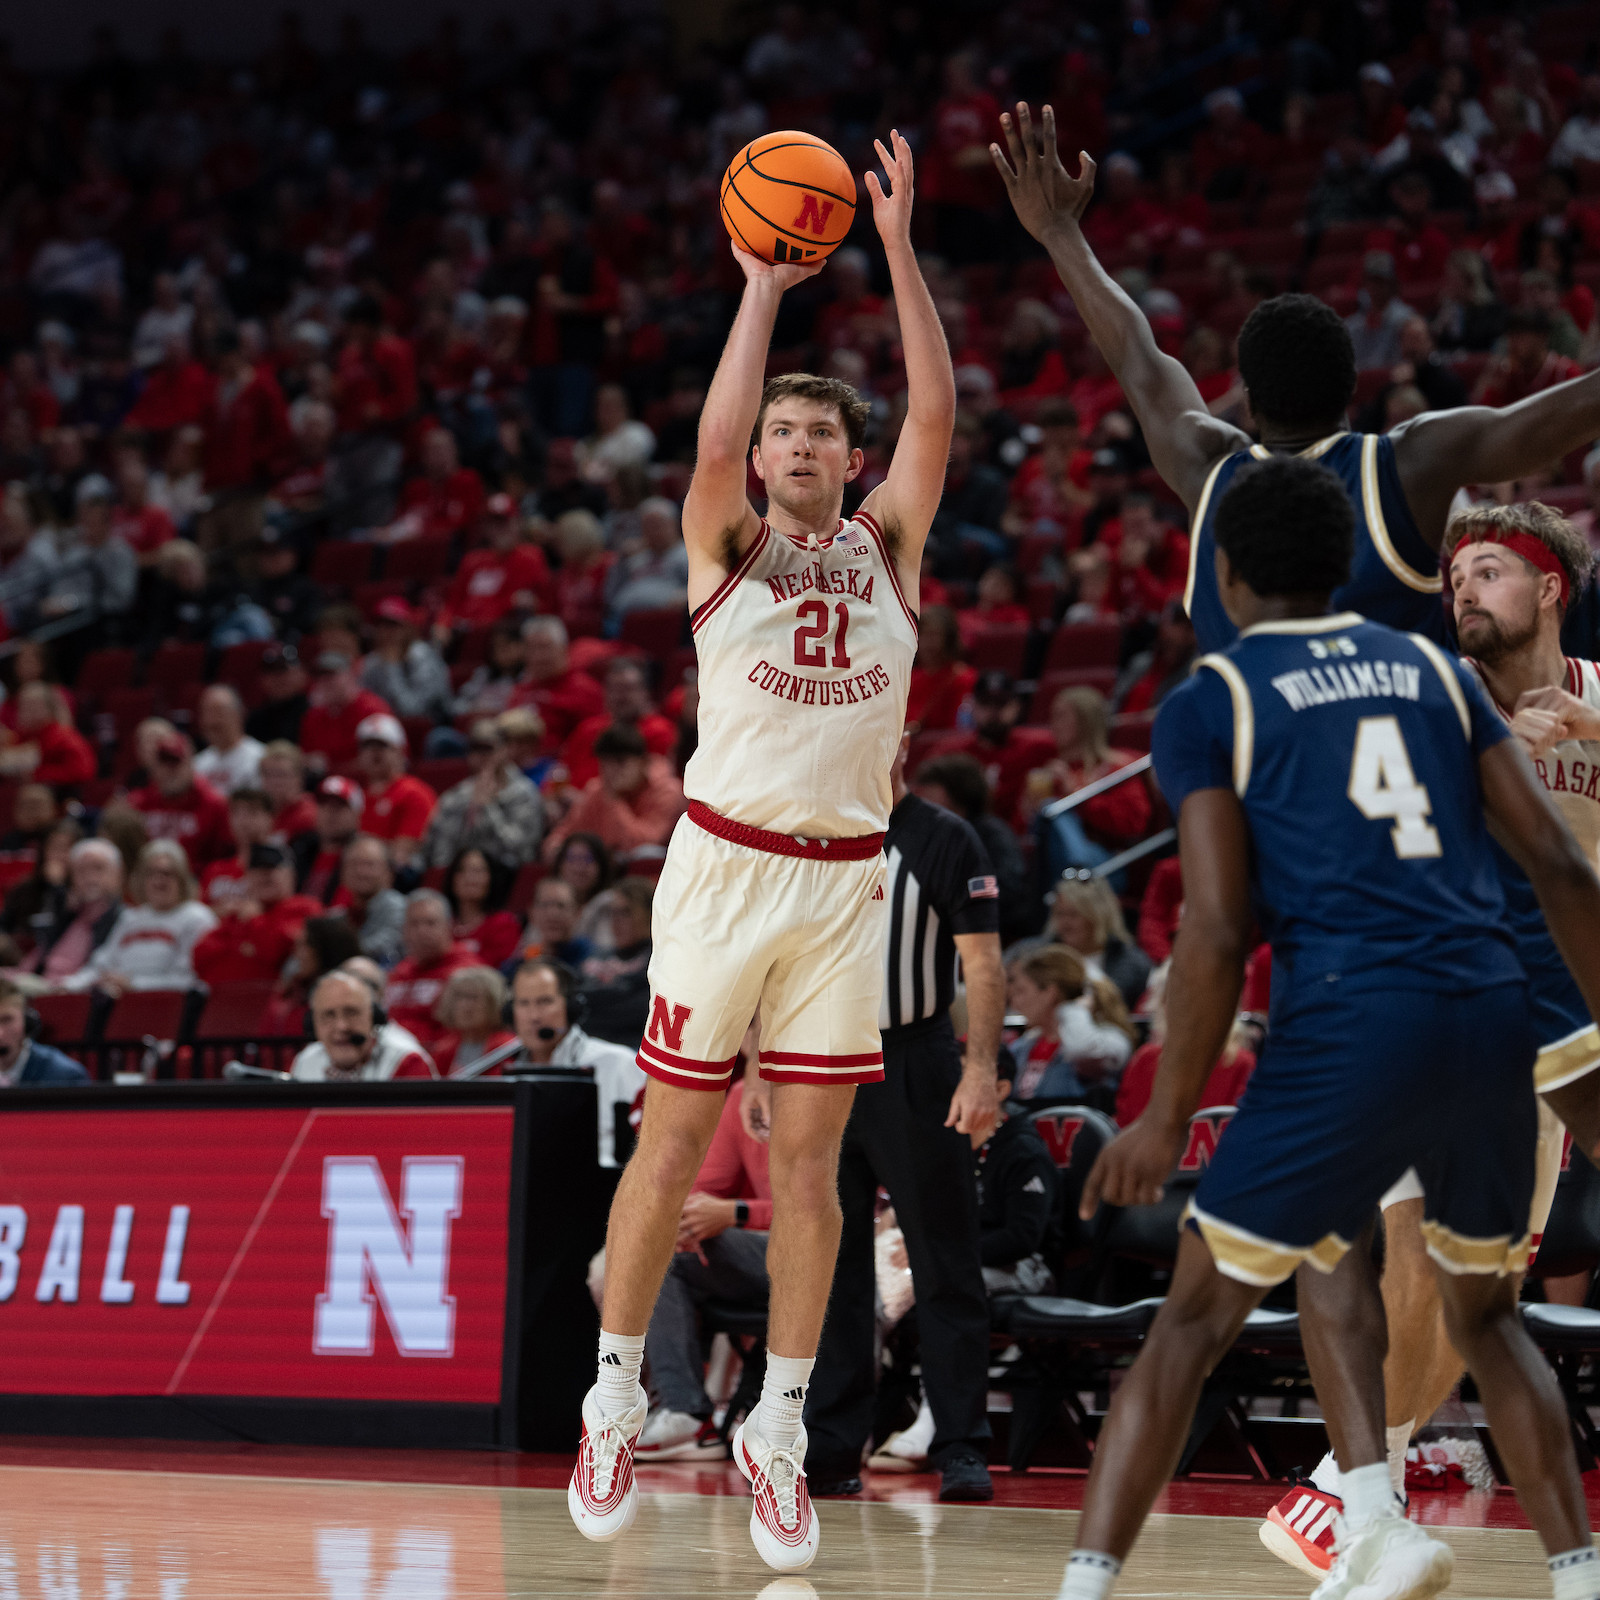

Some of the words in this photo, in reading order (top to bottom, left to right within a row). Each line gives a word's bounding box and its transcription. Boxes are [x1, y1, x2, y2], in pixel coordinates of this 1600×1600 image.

[793, 192, 834, 236] N
[794, 600, 851, 669] 21
[748, 660, 890, 706] CORNHUSKERS
[1271, 661, 1420, 712] WILLIAMSON
[1347, 715, 1443, 860] 4
[1535, 759, 1600, 803] RASK
[648, 993, 693, 1053] N
[312, 1155, 465, 1358] N
